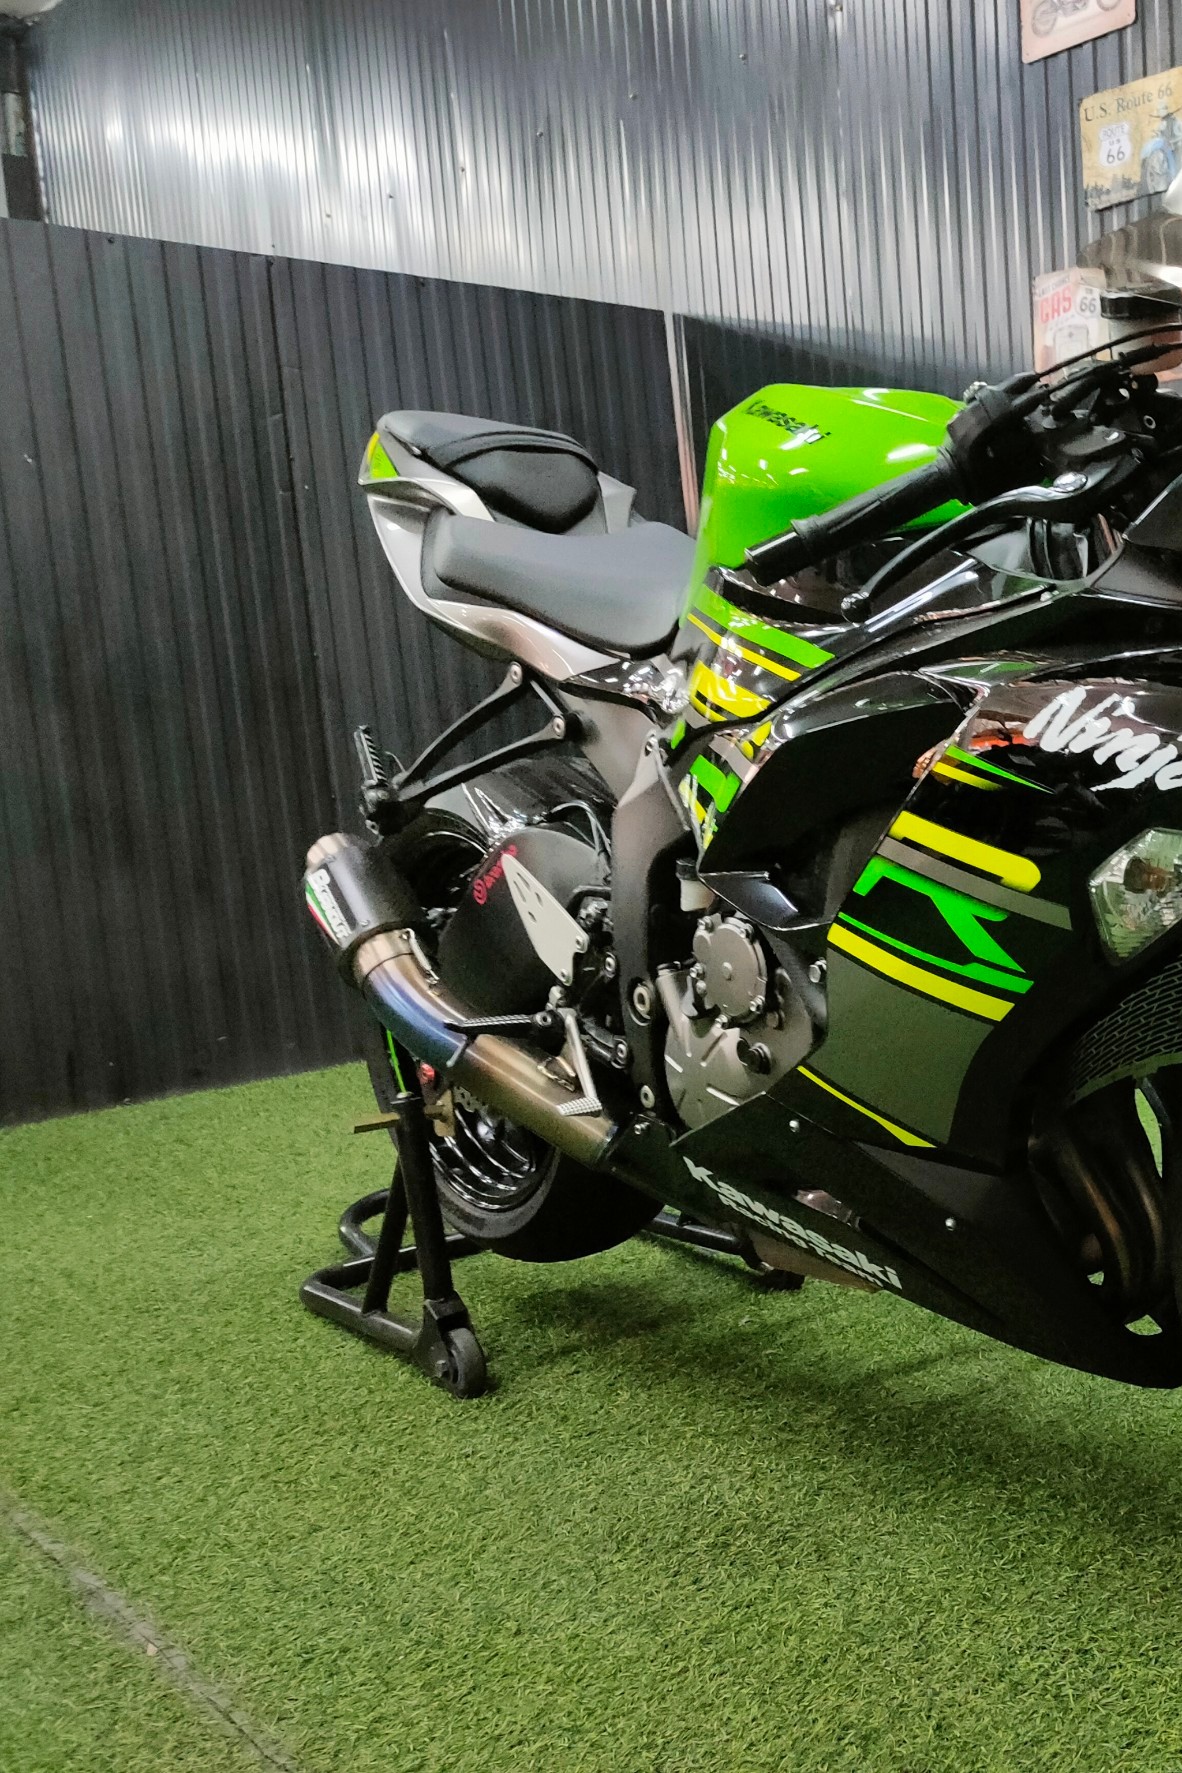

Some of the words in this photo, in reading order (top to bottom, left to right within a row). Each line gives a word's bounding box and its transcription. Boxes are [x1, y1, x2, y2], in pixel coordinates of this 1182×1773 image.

[1116, 92, 1153, 113] Route
[1158, 82, 1173, 99] 66
[1106, 146, 1126, 164] 66
[1041, 284, 1072, 323] GAS
[1080, 297, 1097, 313] 66
[682, 1155, 902, 1289] Kawasaki
[718, 1193, 809, 1249] Racing
[808, 1243, 883, 1287] Team
